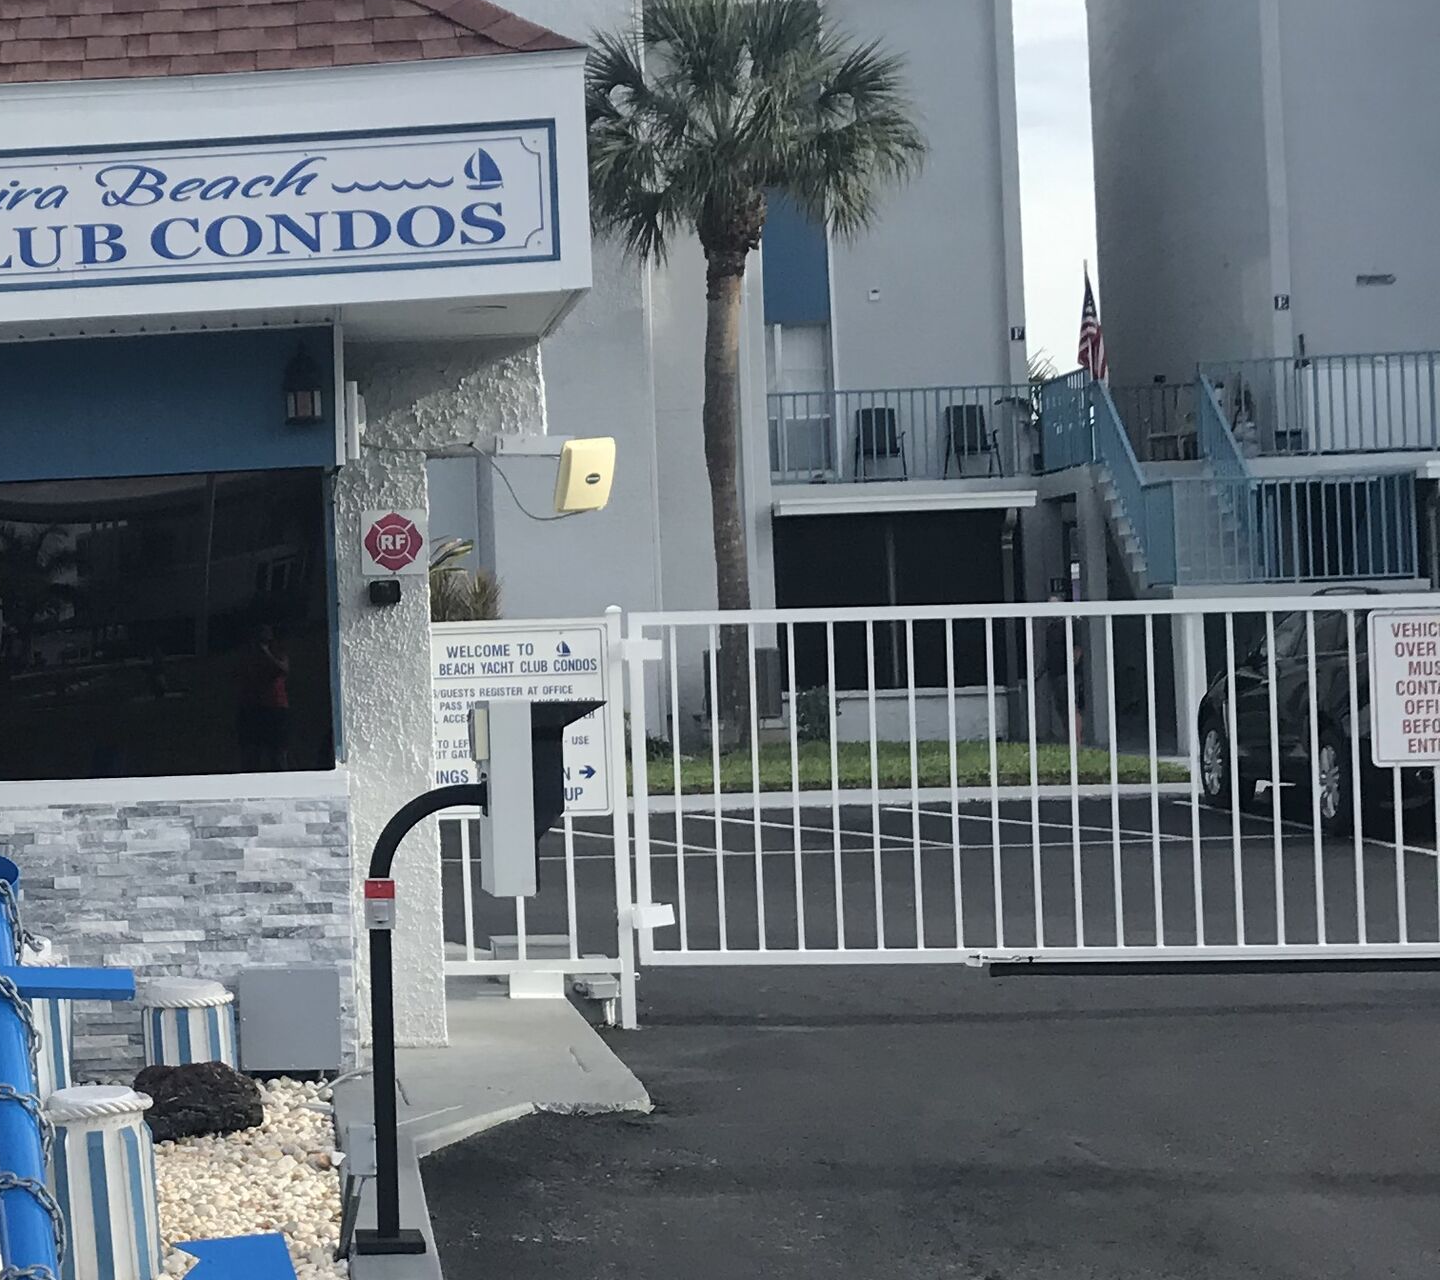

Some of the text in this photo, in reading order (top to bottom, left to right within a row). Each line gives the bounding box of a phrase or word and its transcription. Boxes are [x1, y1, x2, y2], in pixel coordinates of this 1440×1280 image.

[96, 154, 329, 207] Beach
[150, 201, 508, 262] CONDOS
[380, 533, 406, 551] RF
[1391, 622, 1440, 638] VEHIC
[446, 643, 534, 658] WELCOME TO
[1395, 641, 1436, 658] OVER
[439, 658, 598, 676] BEACH YACHT CLUB CONDOS
[479, 686, 523, 697] REGISTER
[527, 686, 539, 695] AT
[542, 685, 574, 695] OFFICE
[1396, 680, 1440, 696] CONT
[439, 701, 463, 711] PASS
[443, 714, 468, 723] ACCE
[437, 740, 449, 749] TO
[571, 735, 590, 745] USE
[1408, 738, 1440, 753] ENT
